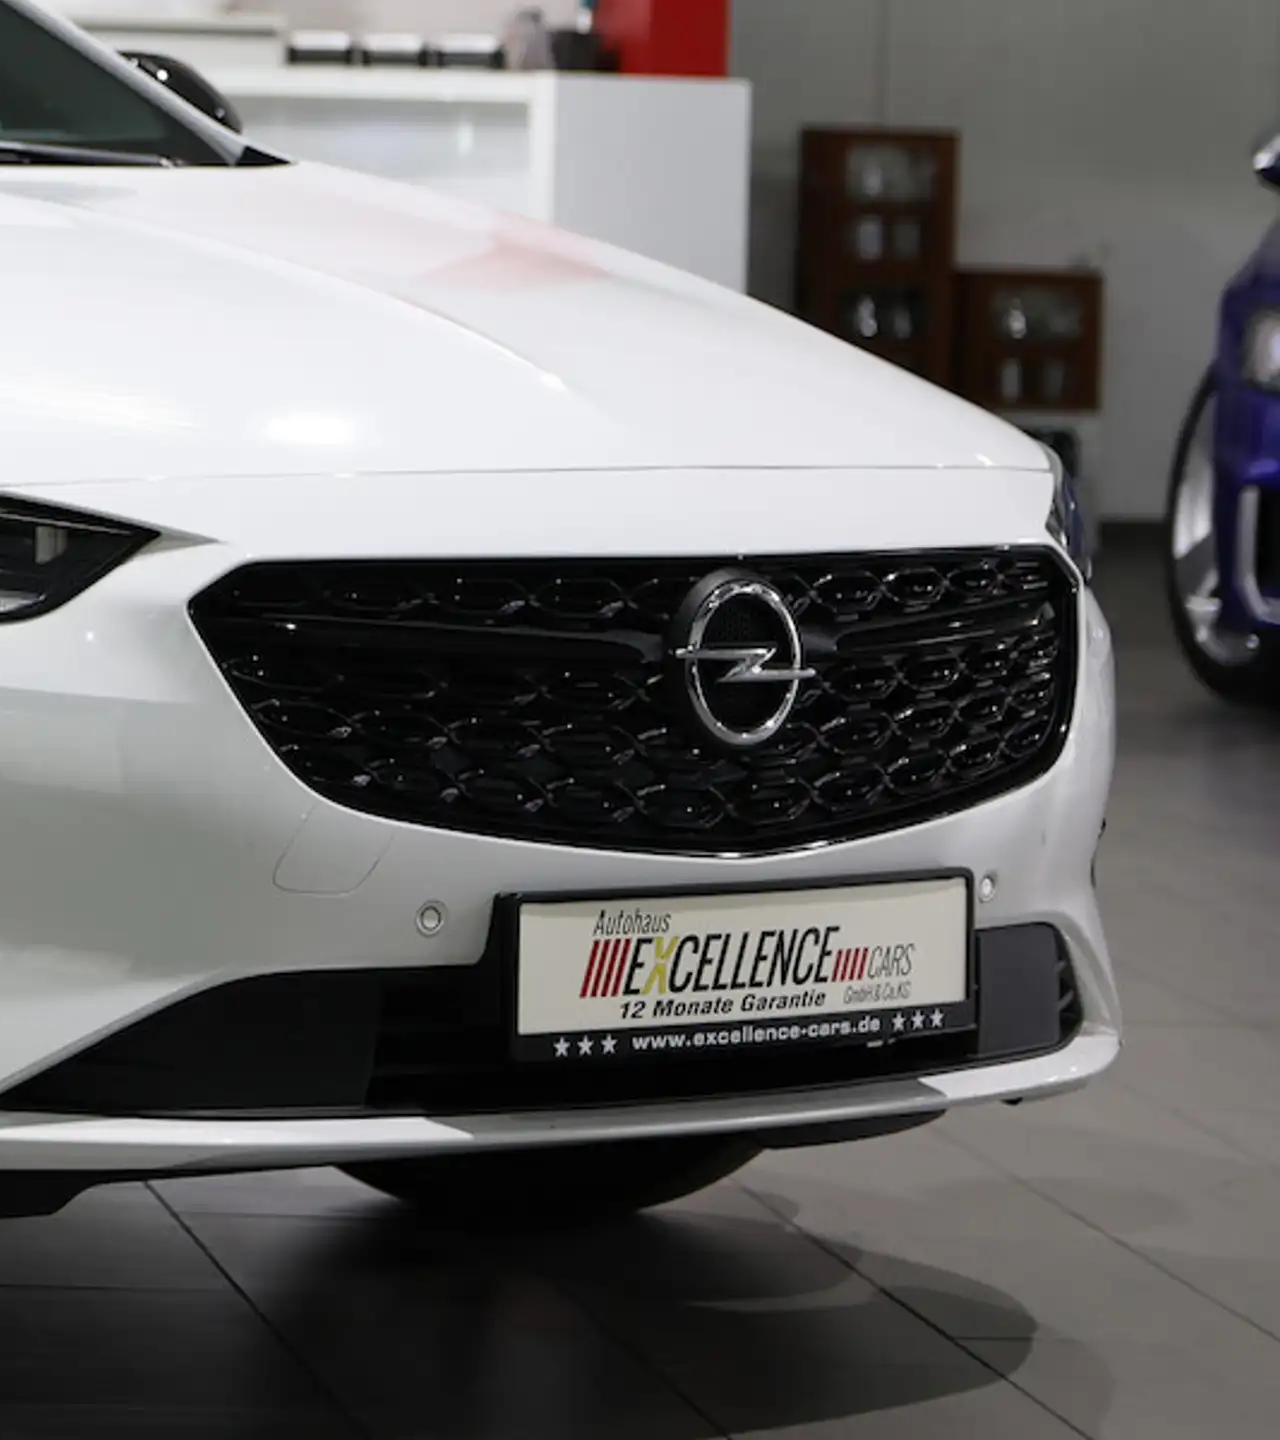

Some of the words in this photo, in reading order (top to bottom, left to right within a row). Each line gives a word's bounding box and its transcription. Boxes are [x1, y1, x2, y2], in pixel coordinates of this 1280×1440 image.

[592, 908, 673, 937] Autohaus
[622, 925, 841, 997] EXCELLENCE
[866, 942, 916, 980] CARS
[619, 1000, 647, 1020] 12
[652, 995, 734, 1018] Monate
[740, 988, 828, 1012] Garantie
[632, 1014, 881, 1050] www.excellence-cars.de
